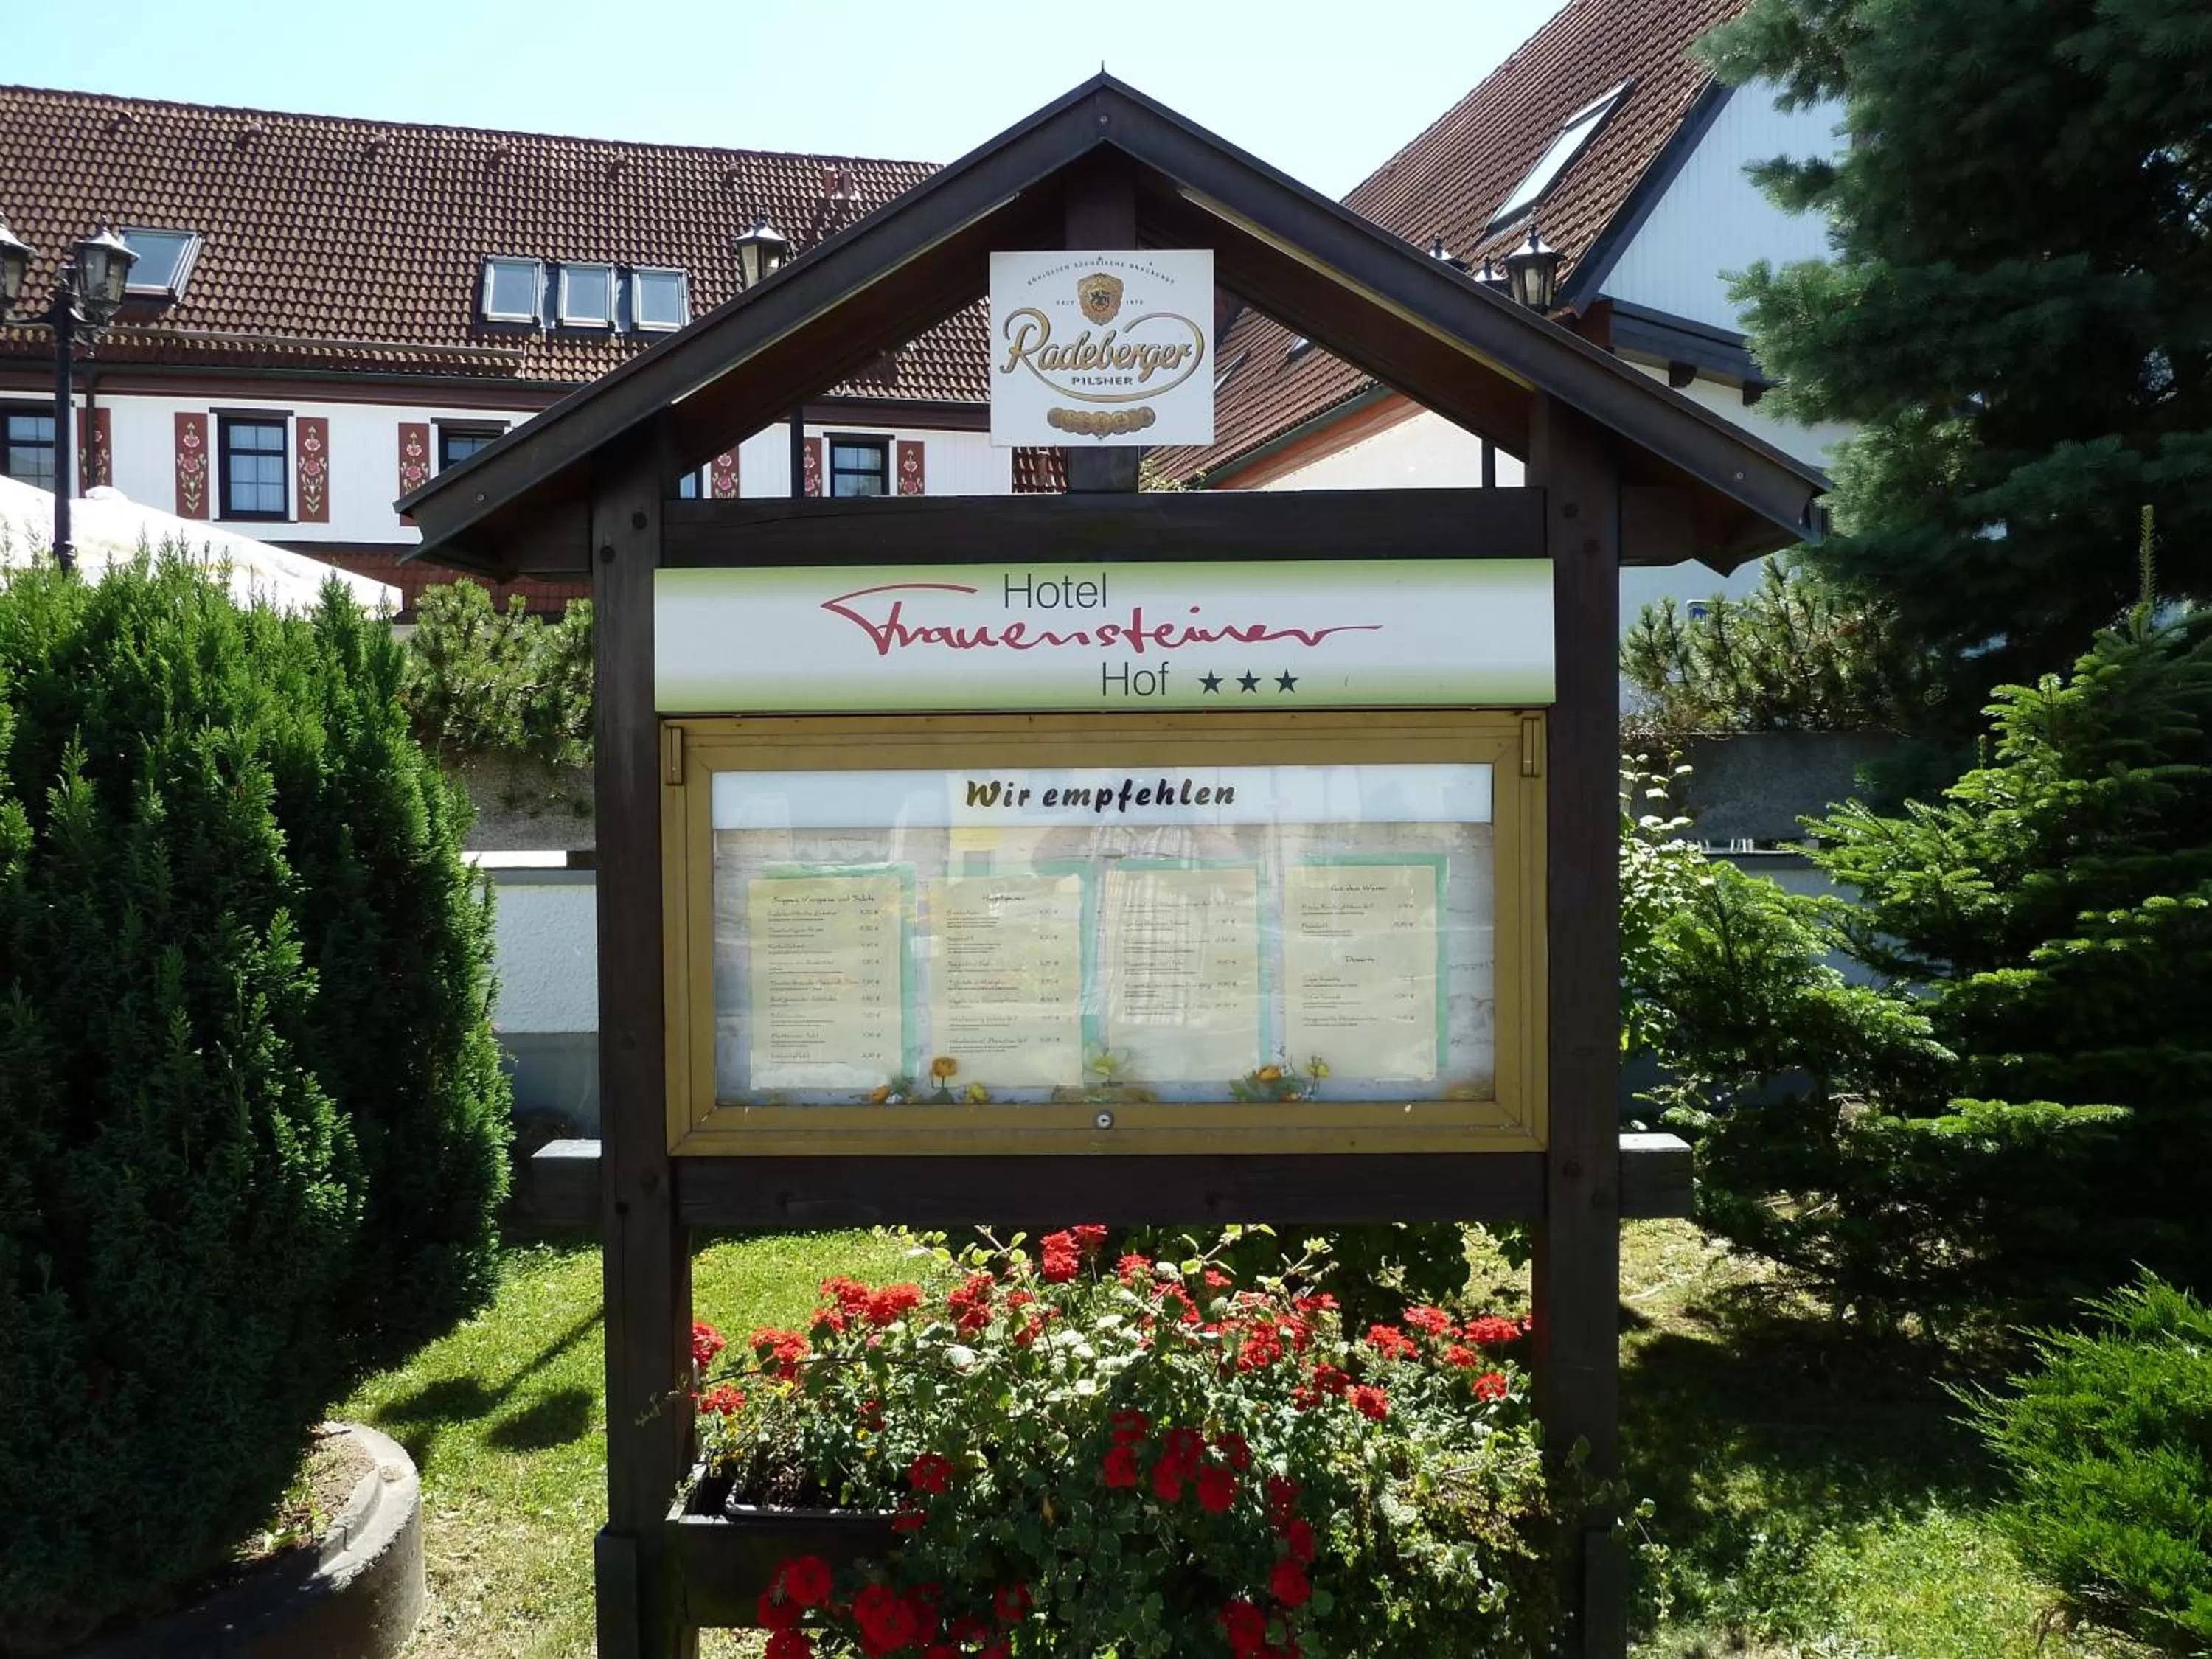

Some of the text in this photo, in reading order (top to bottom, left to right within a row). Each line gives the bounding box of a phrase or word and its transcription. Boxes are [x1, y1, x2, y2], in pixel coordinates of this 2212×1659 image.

[1000, 307, 1194, 383] Radeberger
[1071, 376, 1133, 386] PILSNER
[1004, 572, 1107, 609] Hotel
[821, 583, 1383, 655] Frauensteiner
[1102, 661, 1170, 697] Hof
[967, 778, 1235, 813] Wir empfehlen
